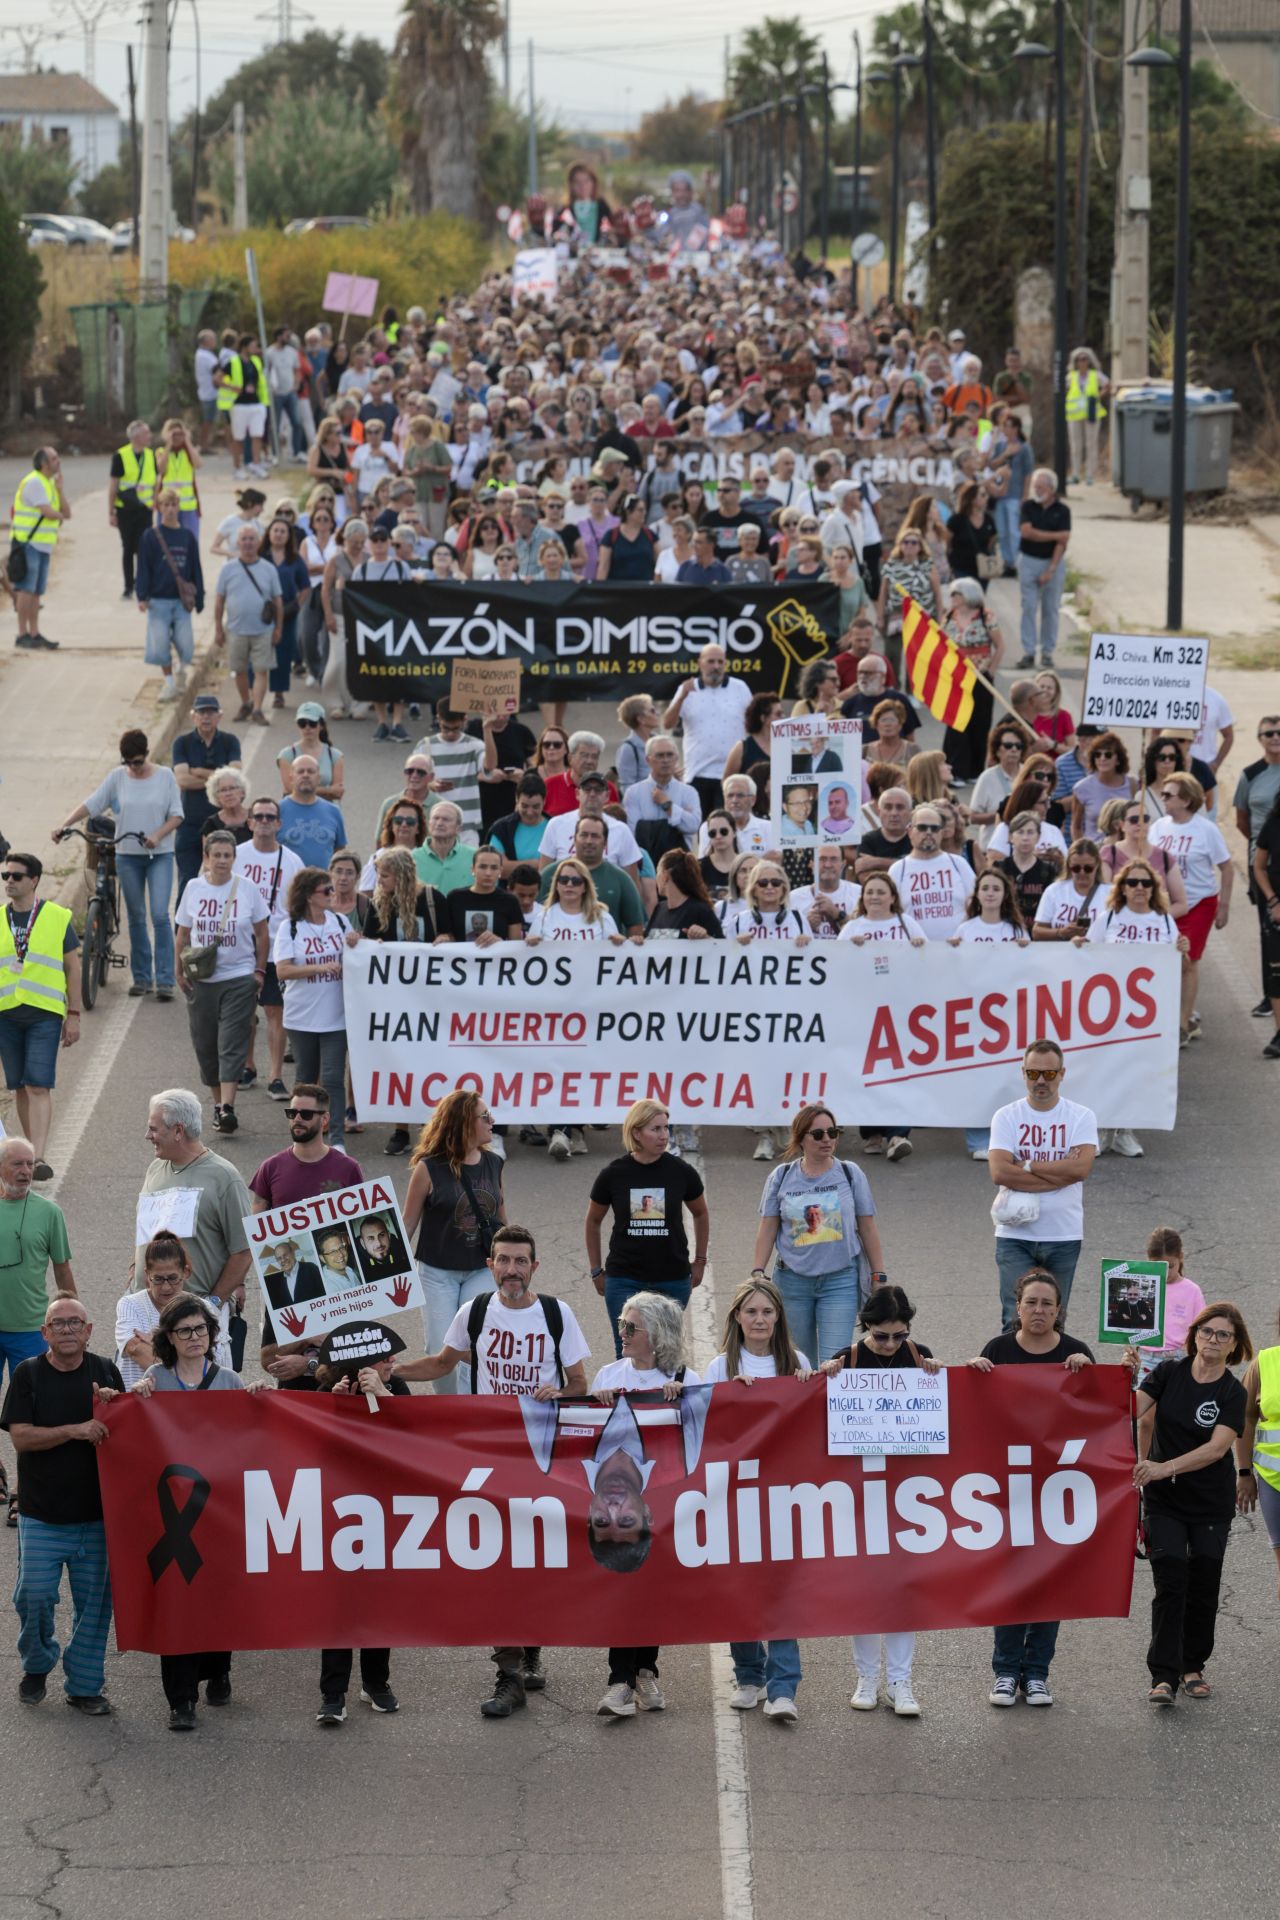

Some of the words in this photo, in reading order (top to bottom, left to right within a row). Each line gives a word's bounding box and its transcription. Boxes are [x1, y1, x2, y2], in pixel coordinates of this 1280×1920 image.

[356, 603, 535, 655] MAZÓN
[556, 604, 764, 655] DIMISSIÓ
[1153, 646, 1173, 664] Km
[1178, 647, 1203, 665] 322
[360, 660, 446, 676] Associació
[530, 661, 549, 675] de
[556, 661, 570, 674] la
[576, 661, 621, 674] DANA
[627, 660, 648, 673] 29
[653, 659, 699, 673] octub
[724, 659, 762, 672] 2024
[458, 682, 479, 693] DEL
[1103, 673, 1149, 687] Dirección
[1152, 676, 1191, 688] Valencia
[1087, 697, 1157, 719] 29/10/2024
[1167, 700, 1200, 720] 19:50
[910, 870, 953, 892] 20:11
[911, 894, 922, 906] NI
[924, 891, 953, 905] OBLIT
[914, 908, 923, 919] NI
[197, 921, 206, 931] NI
[1117, 923, 1160, 941] 20:11
[368, 955, 572, 986] NUESTROS
[597, 955, 827, 985] FAMILIARES
[368, 1012, 440, 1041] HAN
[450, 1012, 587, 1041] MUERTO
[597, 1012, 665, 1041] POR
[677, 1012, 825, 1042] VUESTRA
[862, 967, 1157, 1075] ASESINOS
[369, 1072, 754, 1108] INCOMPETENCIA
[781, 1072, 827, 1109] !!!
[1019, 1124, 1066, 1148] 20:11
[1019, 1150, 1030, 1161] NI
[1034, 1151, 1065, 1162] OBLIT
[252, 1183, 393, 1242] JUSTICIA
[309, 1299, 326, 1311] por
[328, 1293, 341, 1304] mi
[343, 1284, 378, 1301] marido
[321, 1312, 327, 1322] y
[330, 1307, 347, 1318] mis
[349, 1299, 373, 1314] hijos
[332, 1328, 383, 1348] MAZÓN
[487, 1328, 545, 1363] 20:11
[329, 1338, 391, 1362] DIMISSIÓ
[487, 1361, 499, 1379] NI
[503, 1363, 541, 1382] OBLIT
[490, 1380, 501, 1395] NI
[918, 1378, 938, 1388] PARA
[876, 1398, 901, 1410] SARA
[843, 1431, 873, 1441] TODAS
[878, 1432, 894, 1441] LAS
[243, 1468, 568, 1573] Mazón
[673, 1438, 1098, 1568] dimissió
